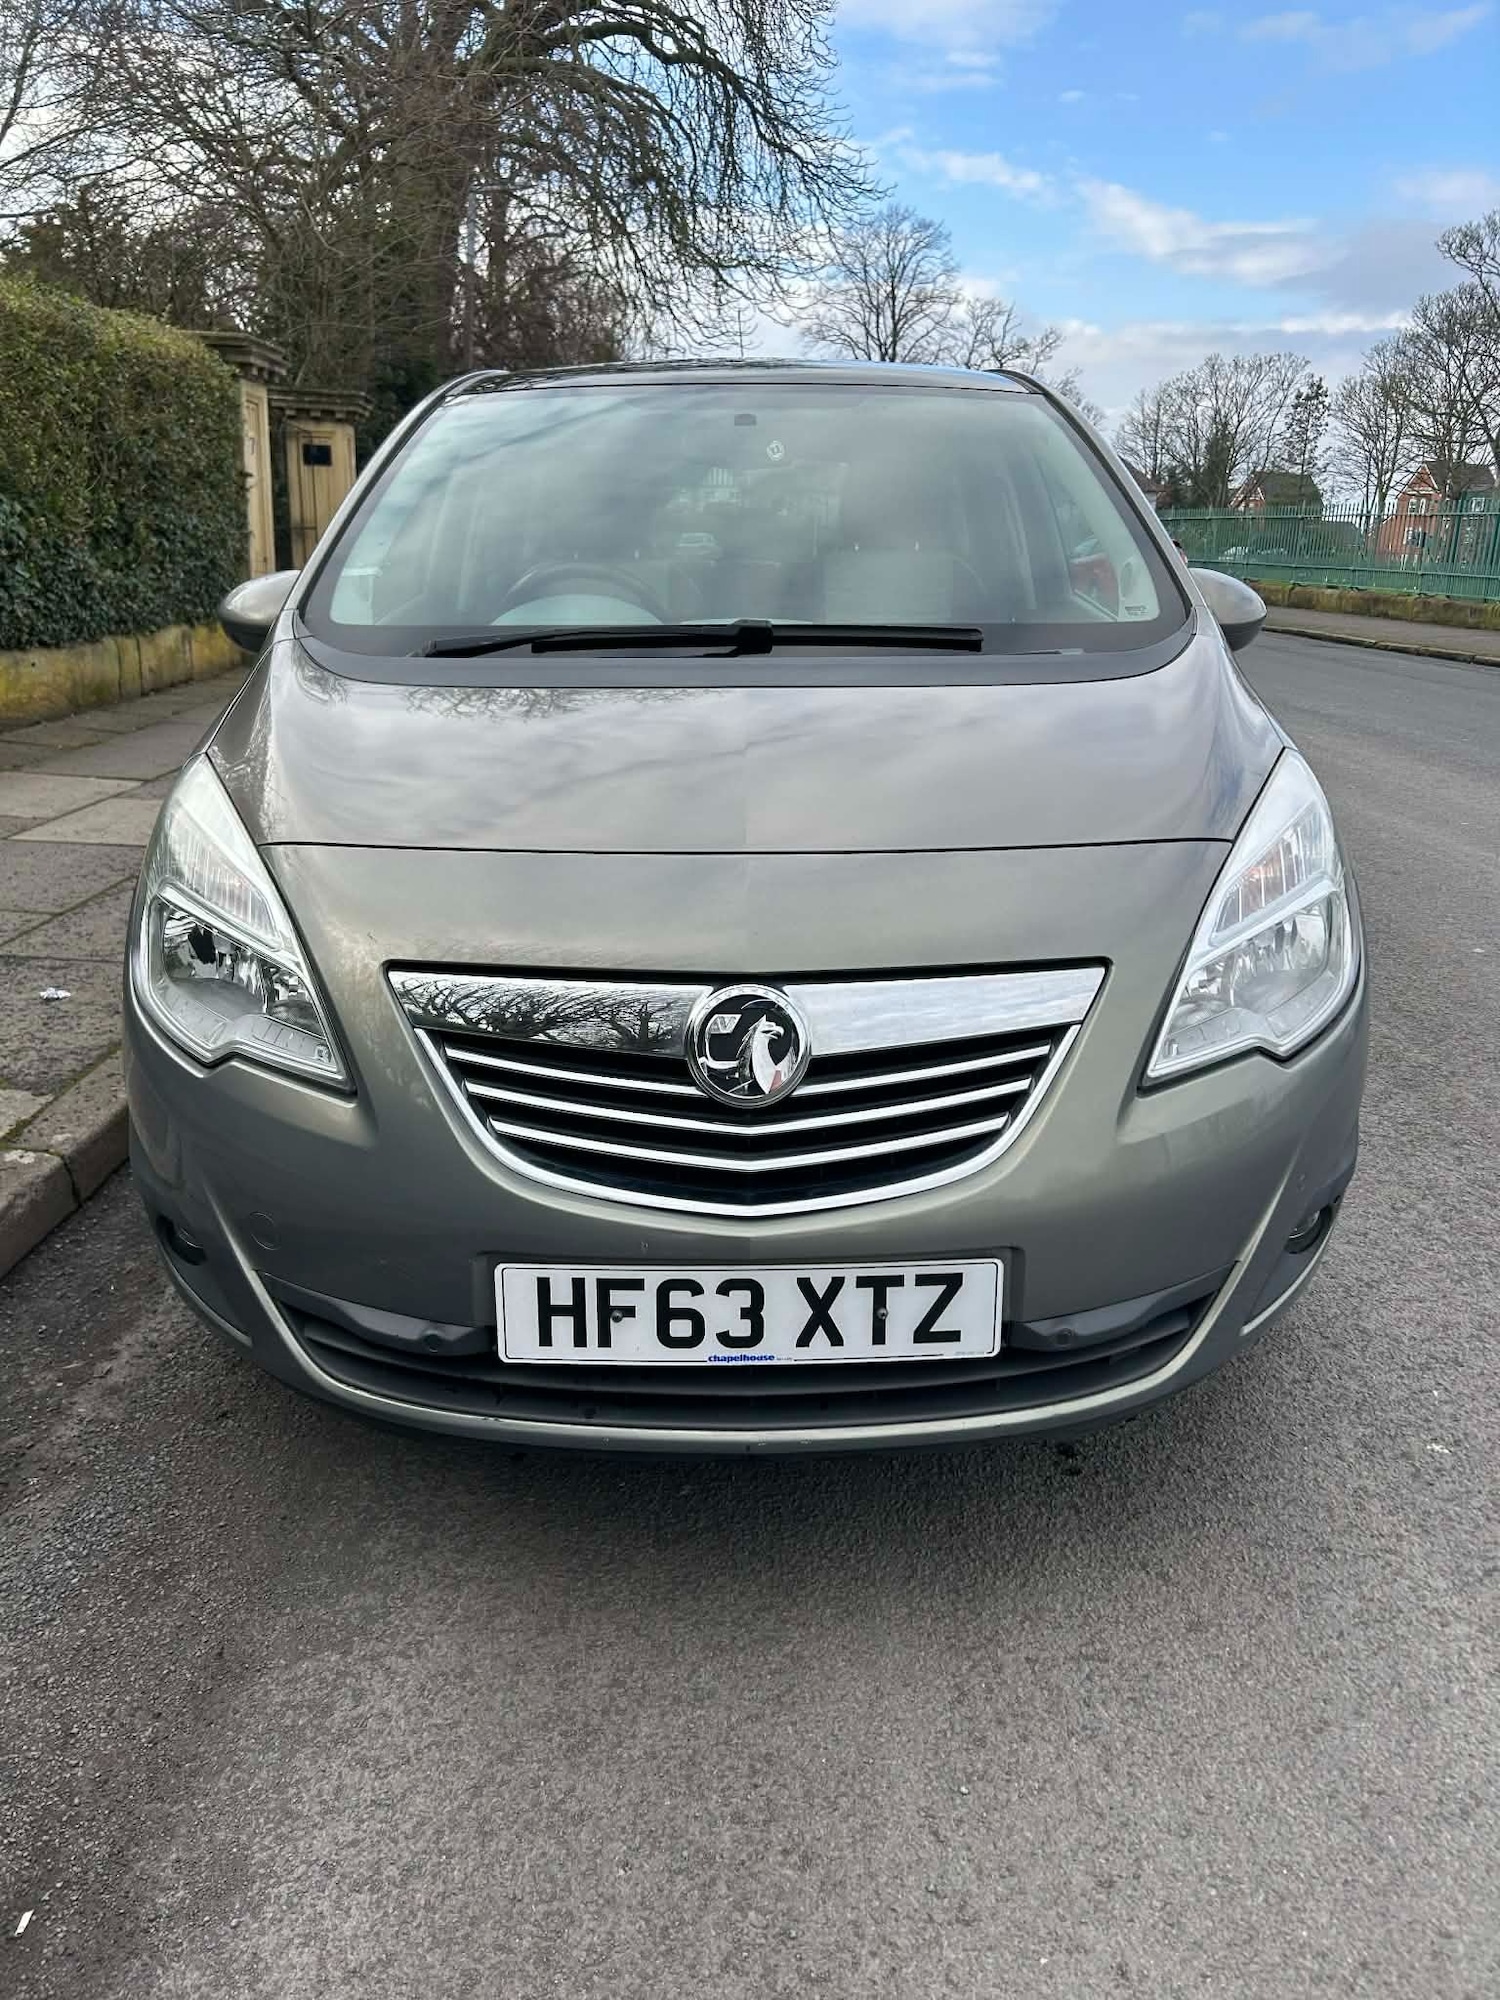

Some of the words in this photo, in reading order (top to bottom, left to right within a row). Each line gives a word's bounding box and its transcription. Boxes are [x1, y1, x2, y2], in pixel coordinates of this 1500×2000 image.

[536, 1277, 765, 1349] HF63
[795, 1272, 964, 1349] XTZ
[708, 1353, 775, 1363] chapelhouse
